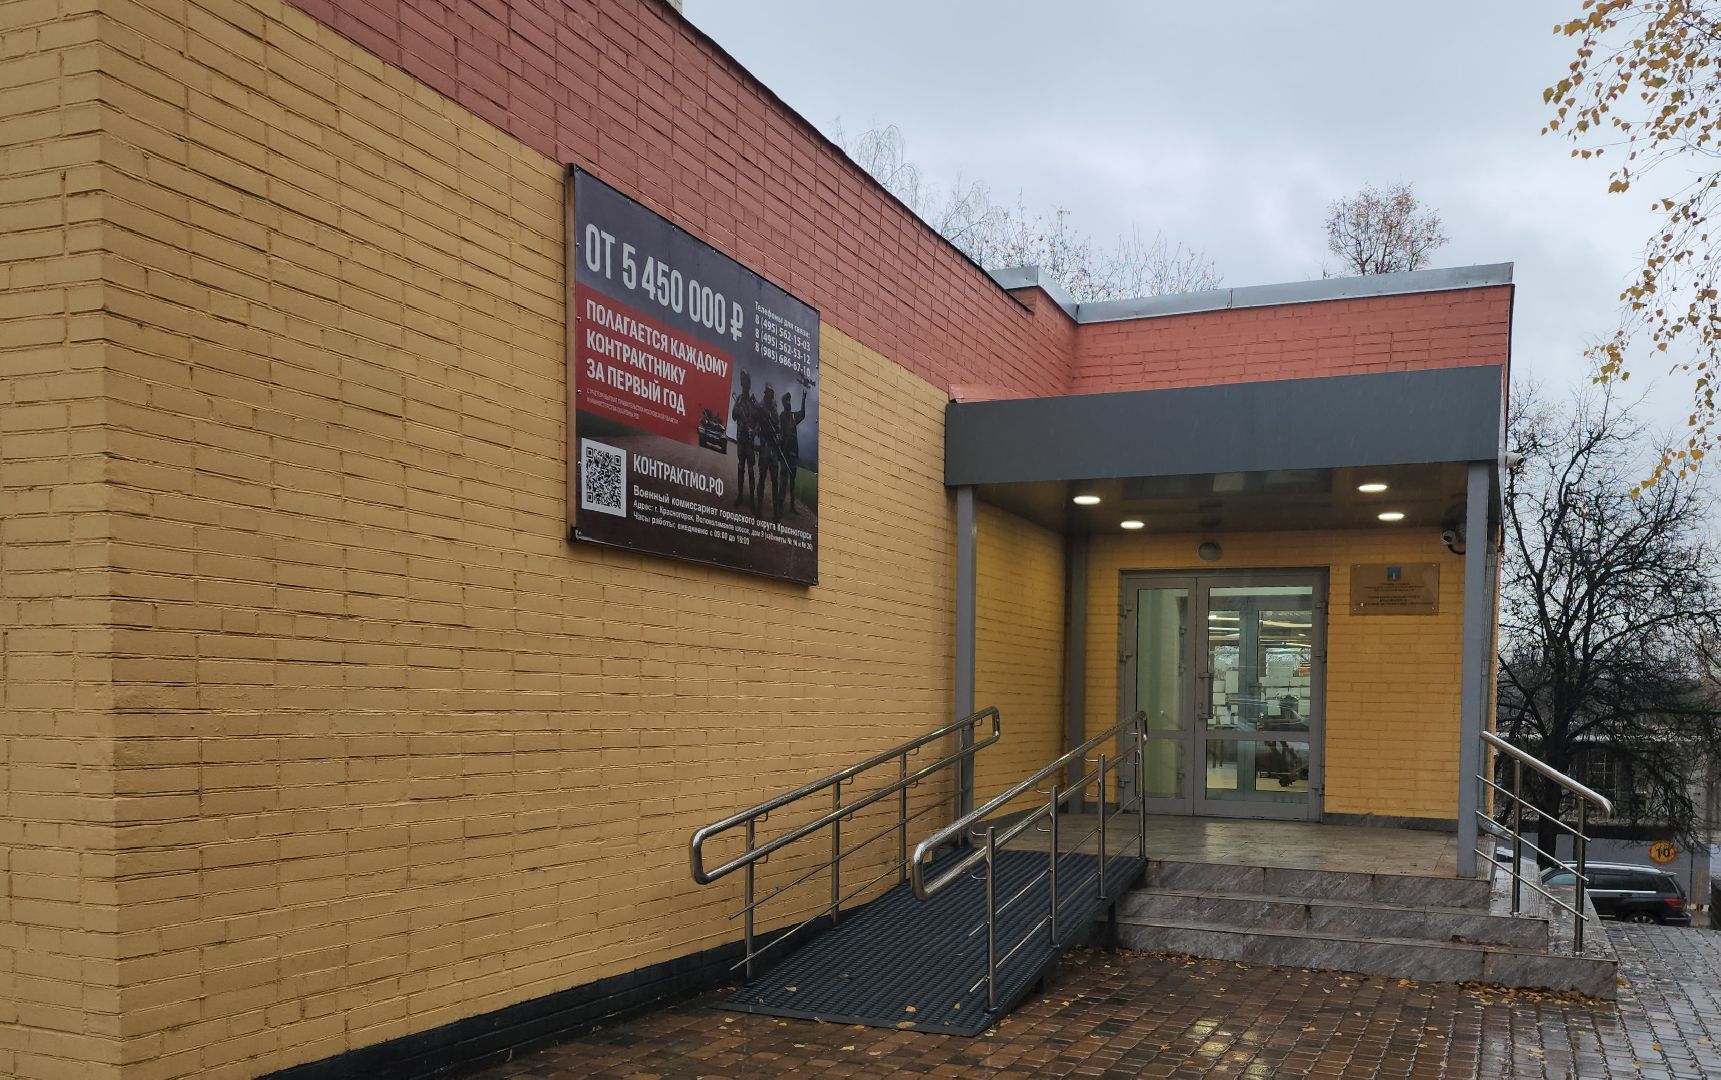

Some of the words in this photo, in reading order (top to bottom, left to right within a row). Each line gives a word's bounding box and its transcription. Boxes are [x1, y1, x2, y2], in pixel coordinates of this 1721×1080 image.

[586, 223, 615, 280] ОТ
[623, 242, 636, 290] 5
[642, 256, 682, 314] 450
[689, 280, 726, 334] 000
[586, 299, 668, 352] ПОЛАГАЕТСЯ
[671, 337, 728, 378] КАЖДОМУ
[586, 329, 686, 385] КОНТРАКТНИКУ
[755, 314, 759, 324] 8
[761, 318, 778, 335] (495)
[779, 328, 810, 352] 562-15-03
[755, 328, 759, 338] 8
[761, 331, 778, 348] (495)
[779, 341, 810, 364] 562-53-12
[755, 342, 759, 352] 8
[761, 345, 778, 362] (985)
[586, 358, 605, 383] ЗА
[608, 366, 660, 403] ПЕРВЫЙ
[664, 387, 686, 416] ГОД
[634, 454, 724, 497] КОНТРАКТМО.РФ
[634, 484, 669, 503] Военный
[672, 498, 718, 515] комиссариат
[720, 510, 755, 525] городского
[777, 523, 812, 540] Красногорск
